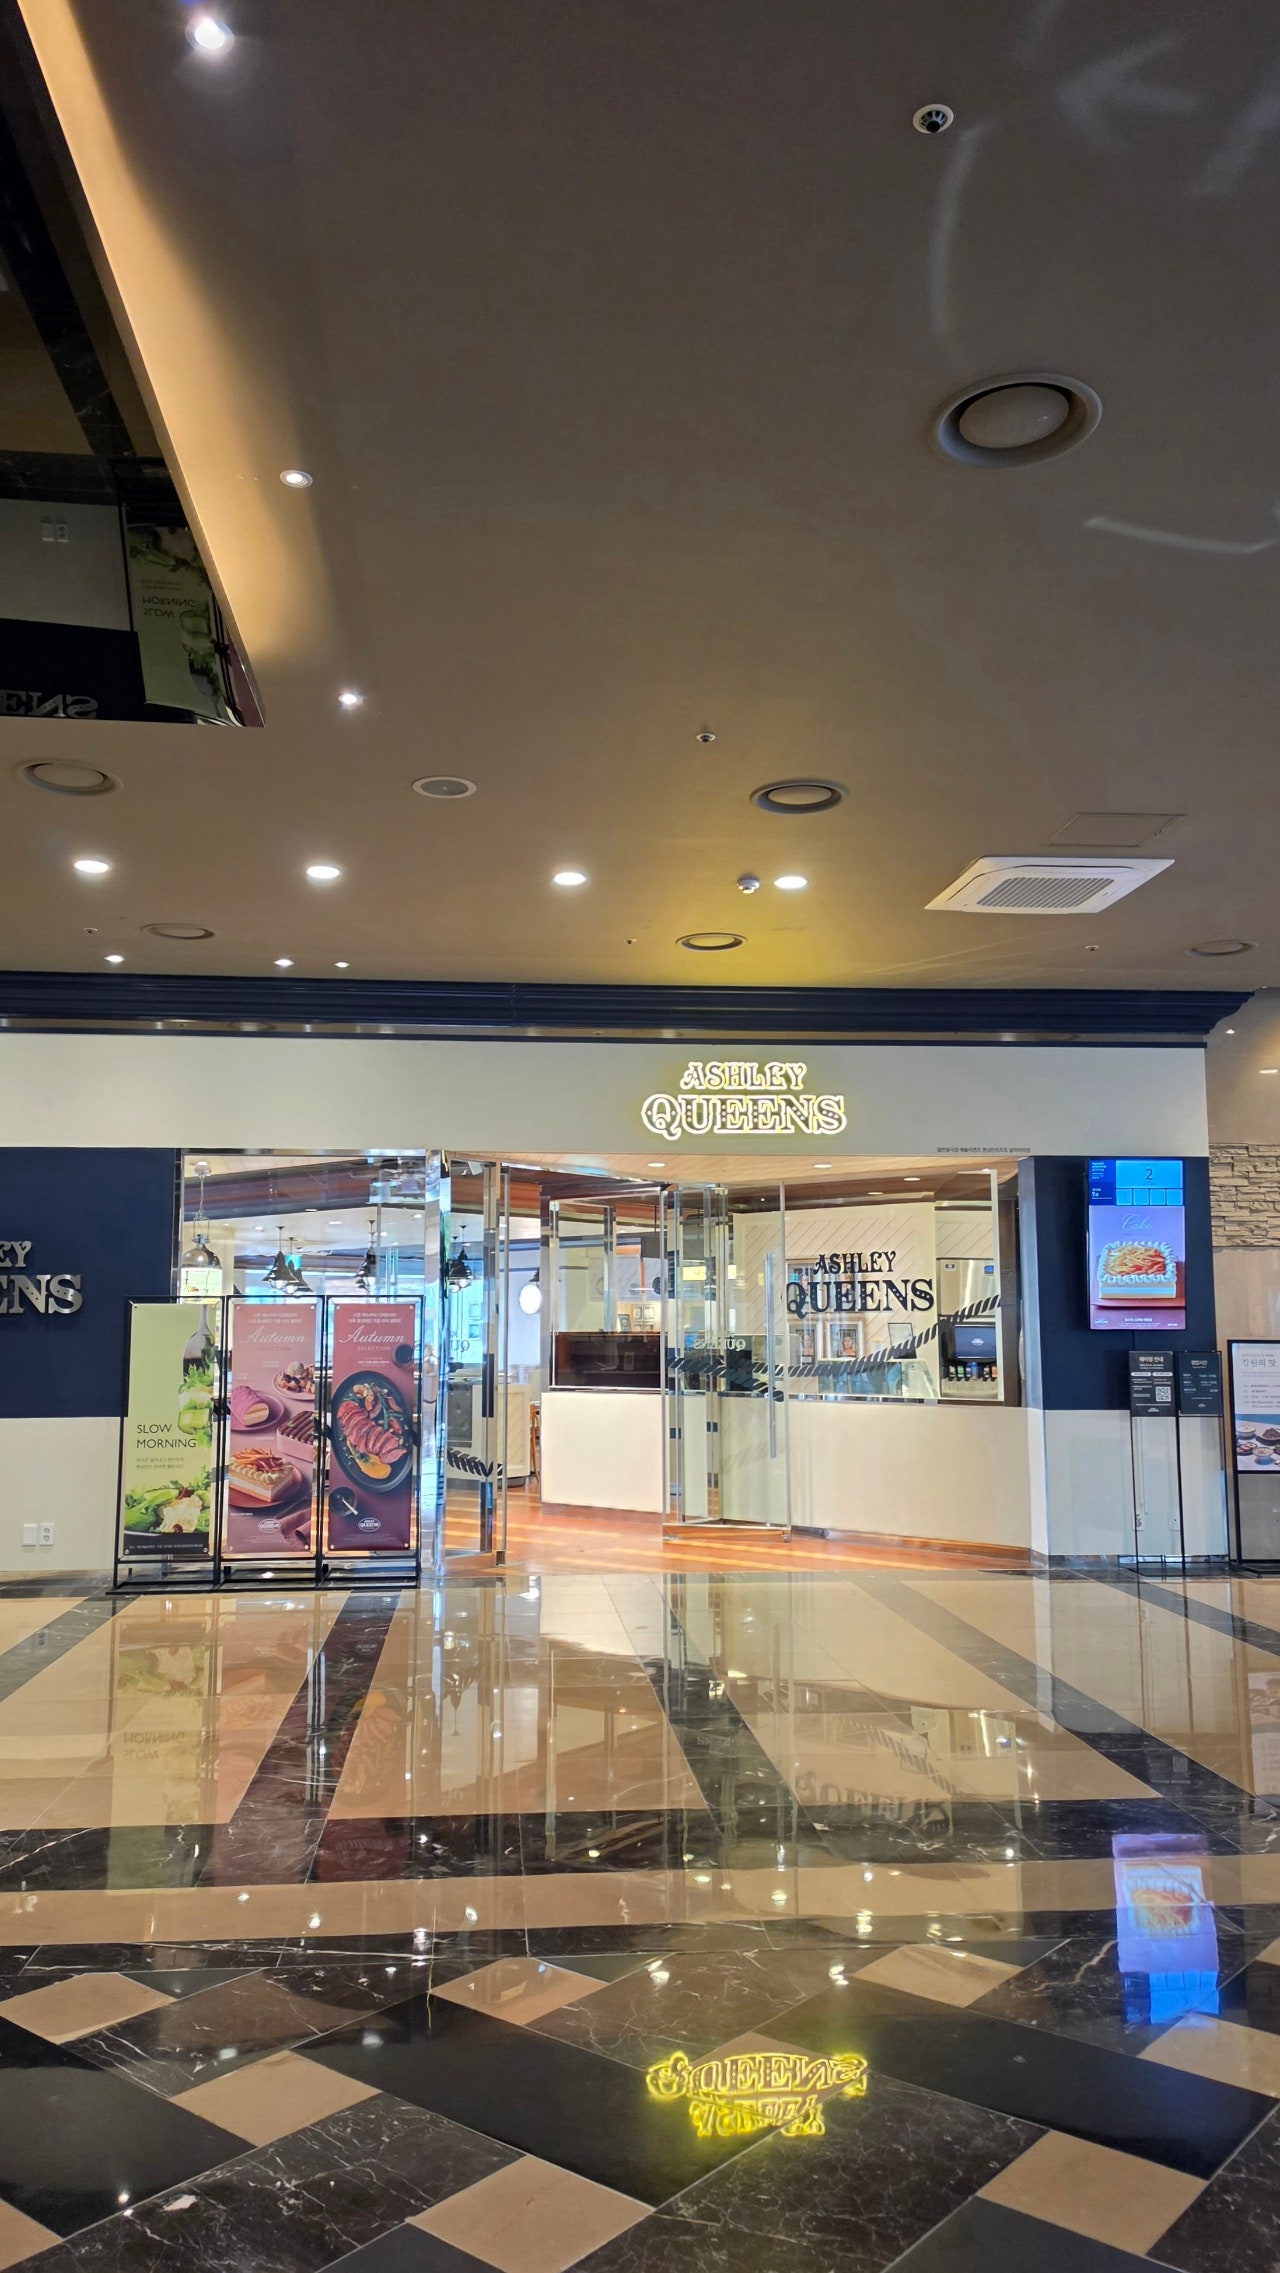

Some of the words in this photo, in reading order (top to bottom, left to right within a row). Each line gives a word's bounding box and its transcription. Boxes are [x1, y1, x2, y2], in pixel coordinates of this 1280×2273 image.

[680, 1061, 807, 1090] ASHLEY
[641, 1093, 847, 1140] QUEENS
[1145, 1168, 1153, 1180] 2
[1122, 1214, 1151, 1231] Cake
[813, 1250, 896, 1275] ASHLEY
[786, 1279, 934, 1319] QUEENS
[240, 1325, 305, 1343] Autumn
[339, 1325, 405, 1343] Autumn
[1242, 1359, 1266, 1367] 강원의
[1268, 1359, 1276, 1367] 맛
[137, 1424, 172, 1434] SLOW
[136, 1438, 197, 1448] MORNING
